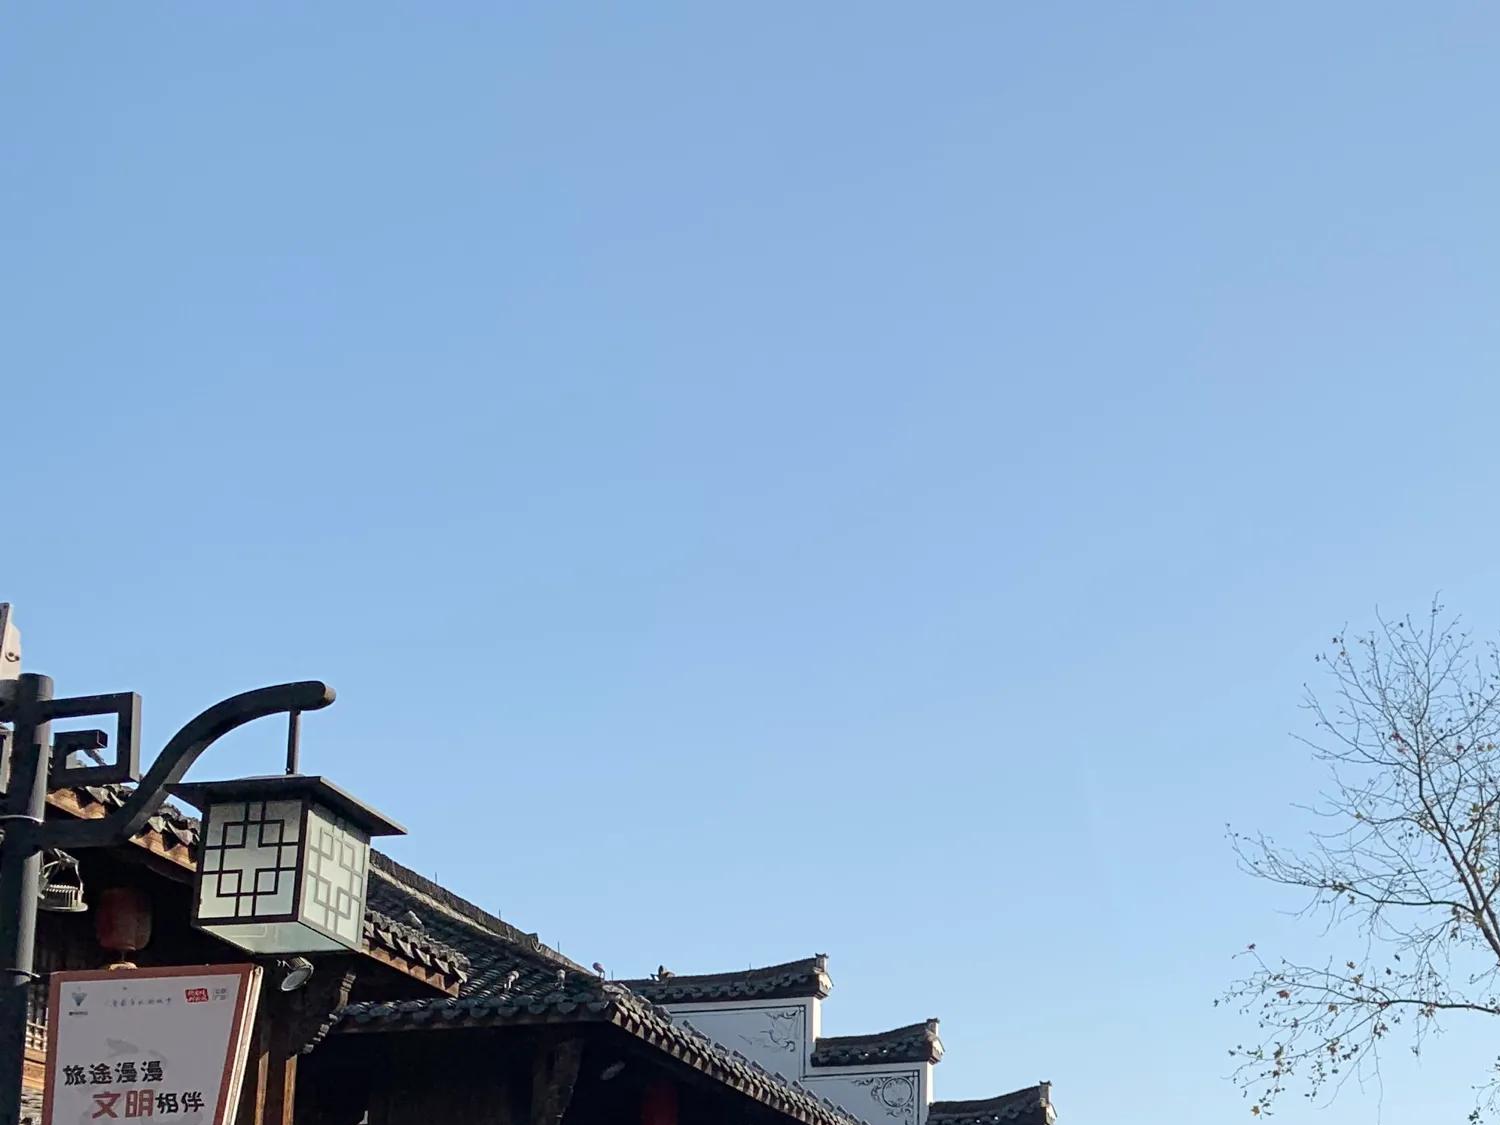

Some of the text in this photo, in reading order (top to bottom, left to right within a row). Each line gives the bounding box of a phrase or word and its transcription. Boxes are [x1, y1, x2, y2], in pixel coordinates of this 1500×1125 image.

[62, 1060, 164, 1086] 旅途漫漫
[92, 1089, 205, 1119] 文明相伴
